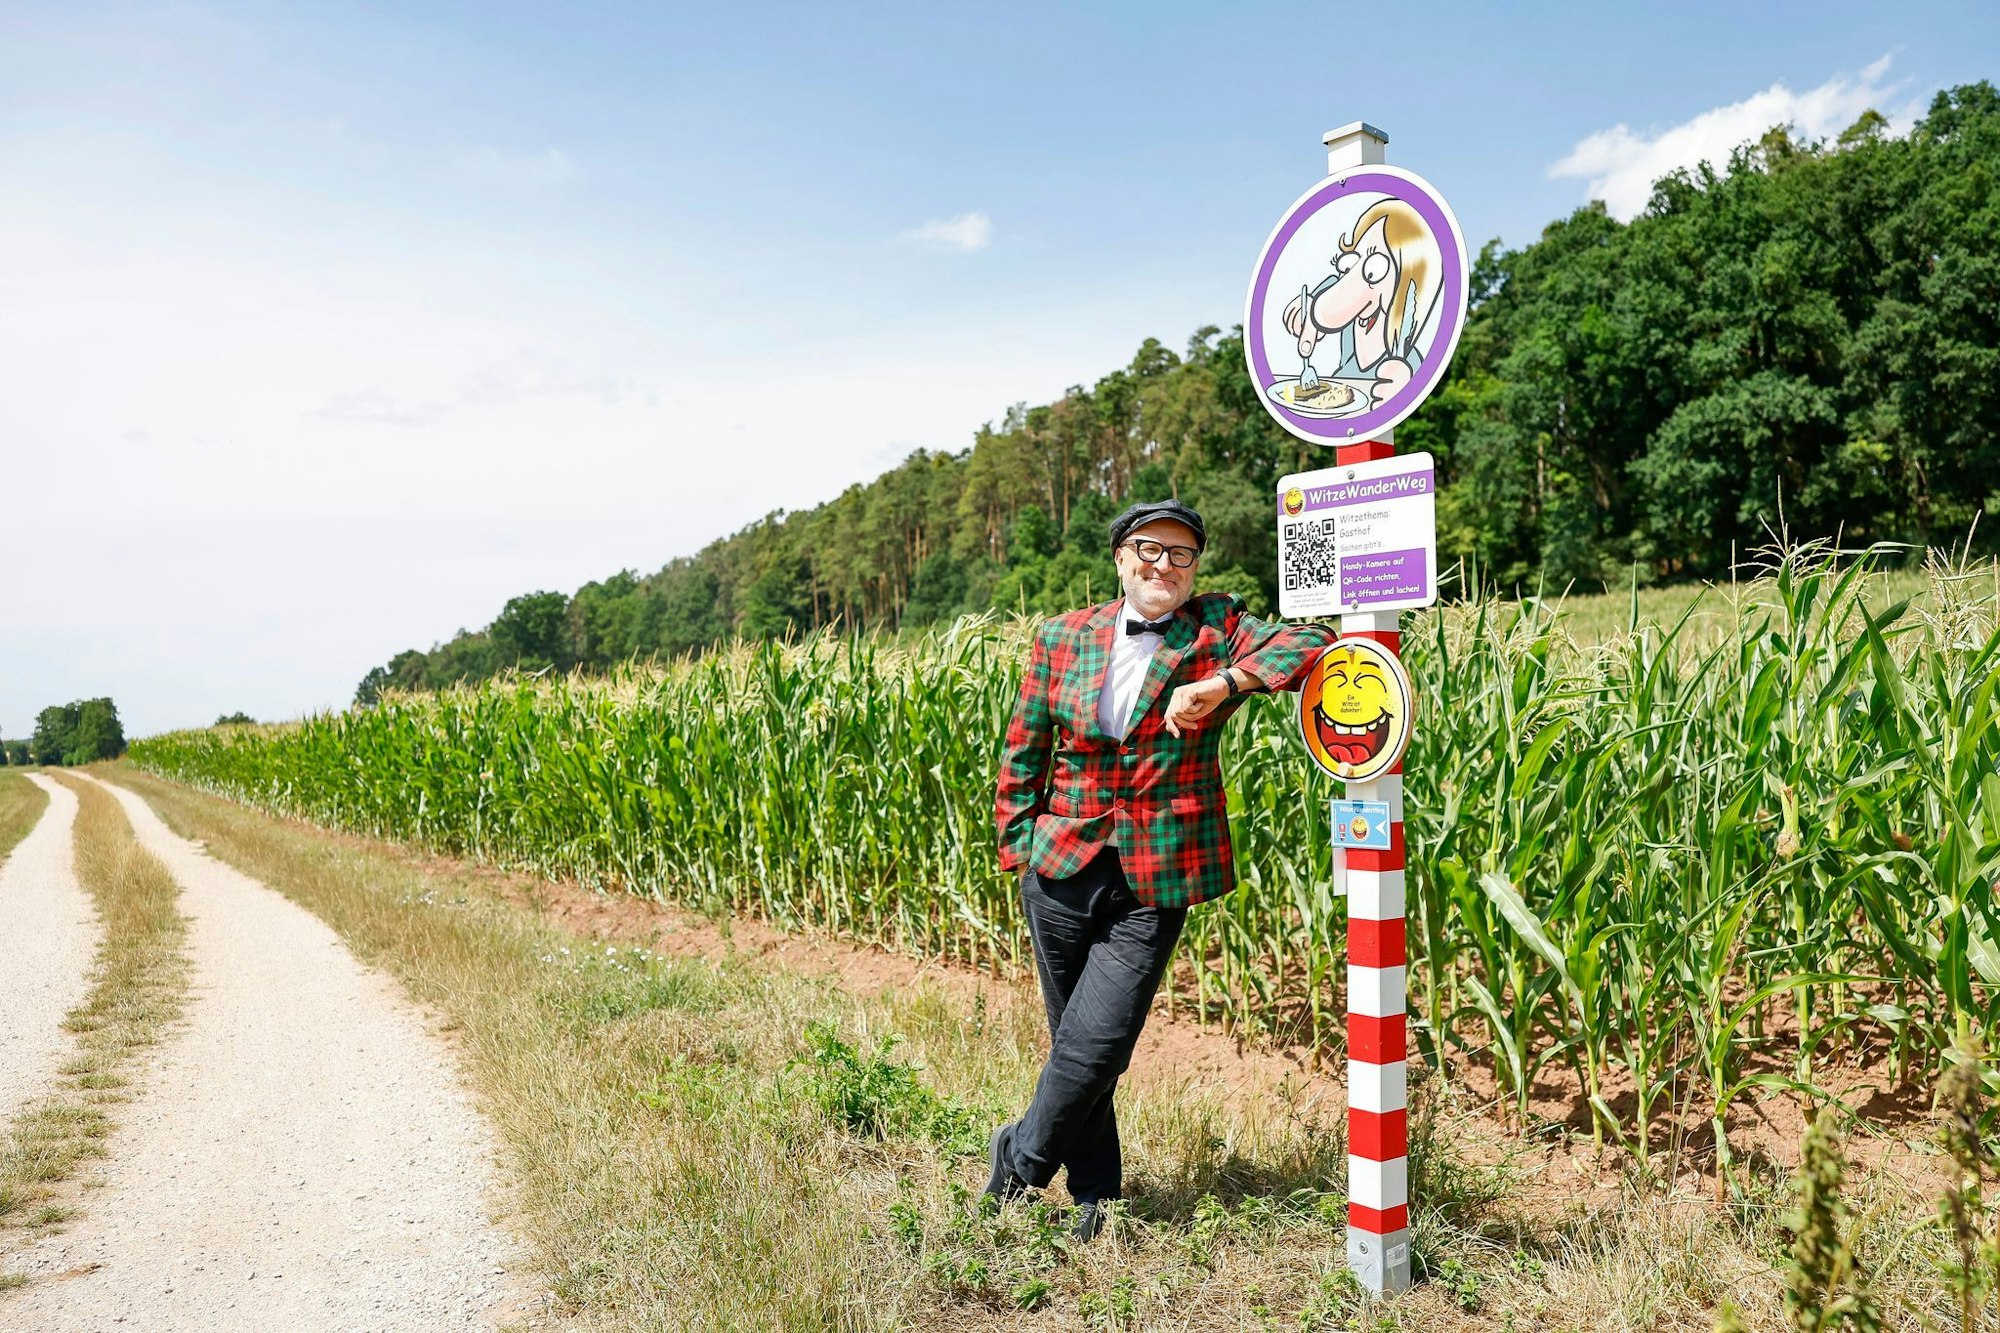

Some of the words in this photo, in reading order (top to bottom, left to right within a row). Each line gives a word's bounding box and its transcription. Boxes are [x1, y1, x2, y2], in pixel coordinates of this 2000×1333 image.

[1309, 476, 1427, 504] WitzeWanderWeg
[1339, 525, 1371, 538] Gasthof
[1342, 560, 1391, 571] Handy-Kamera
[1392, 556, 1405, 565] auf
[1342, 574, 1373, 586] QR-Code
[1343, 590, 1357, 599] Link
[1358, 589, 1381, 598] öffnen
[1382, 586, 1394, 596] und
[1396, 584, 1420, 594] lachen!
